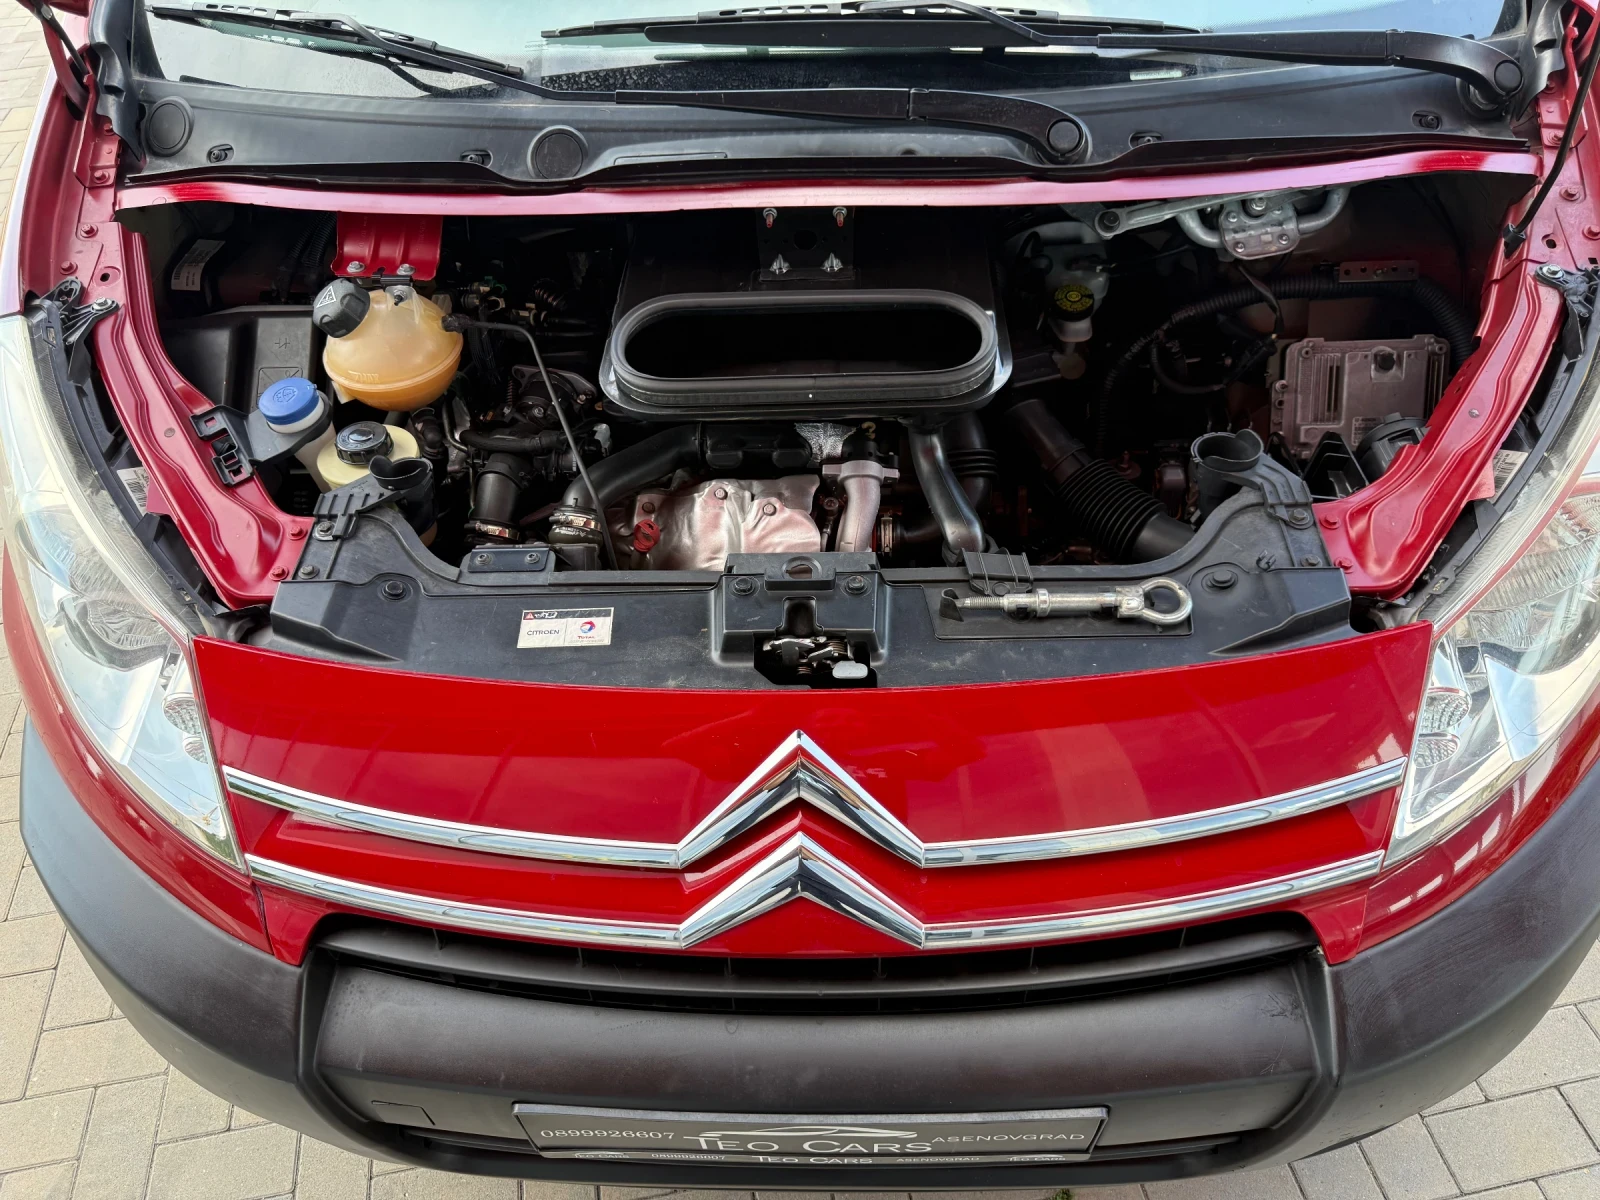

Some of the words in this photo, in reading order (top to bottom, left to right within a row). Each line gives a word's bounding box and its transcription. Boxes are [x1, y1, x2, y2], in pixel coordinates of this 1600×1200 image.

[540, 1129, 675, 1140] 0899926607
[931, 1133, 1085, 1143] ASENOVGRAD
[683, 1136, 780, 1151] TEO
[803, 1140, 932, 1153] CARS
[752, 1155, 799, 1163] TEO
